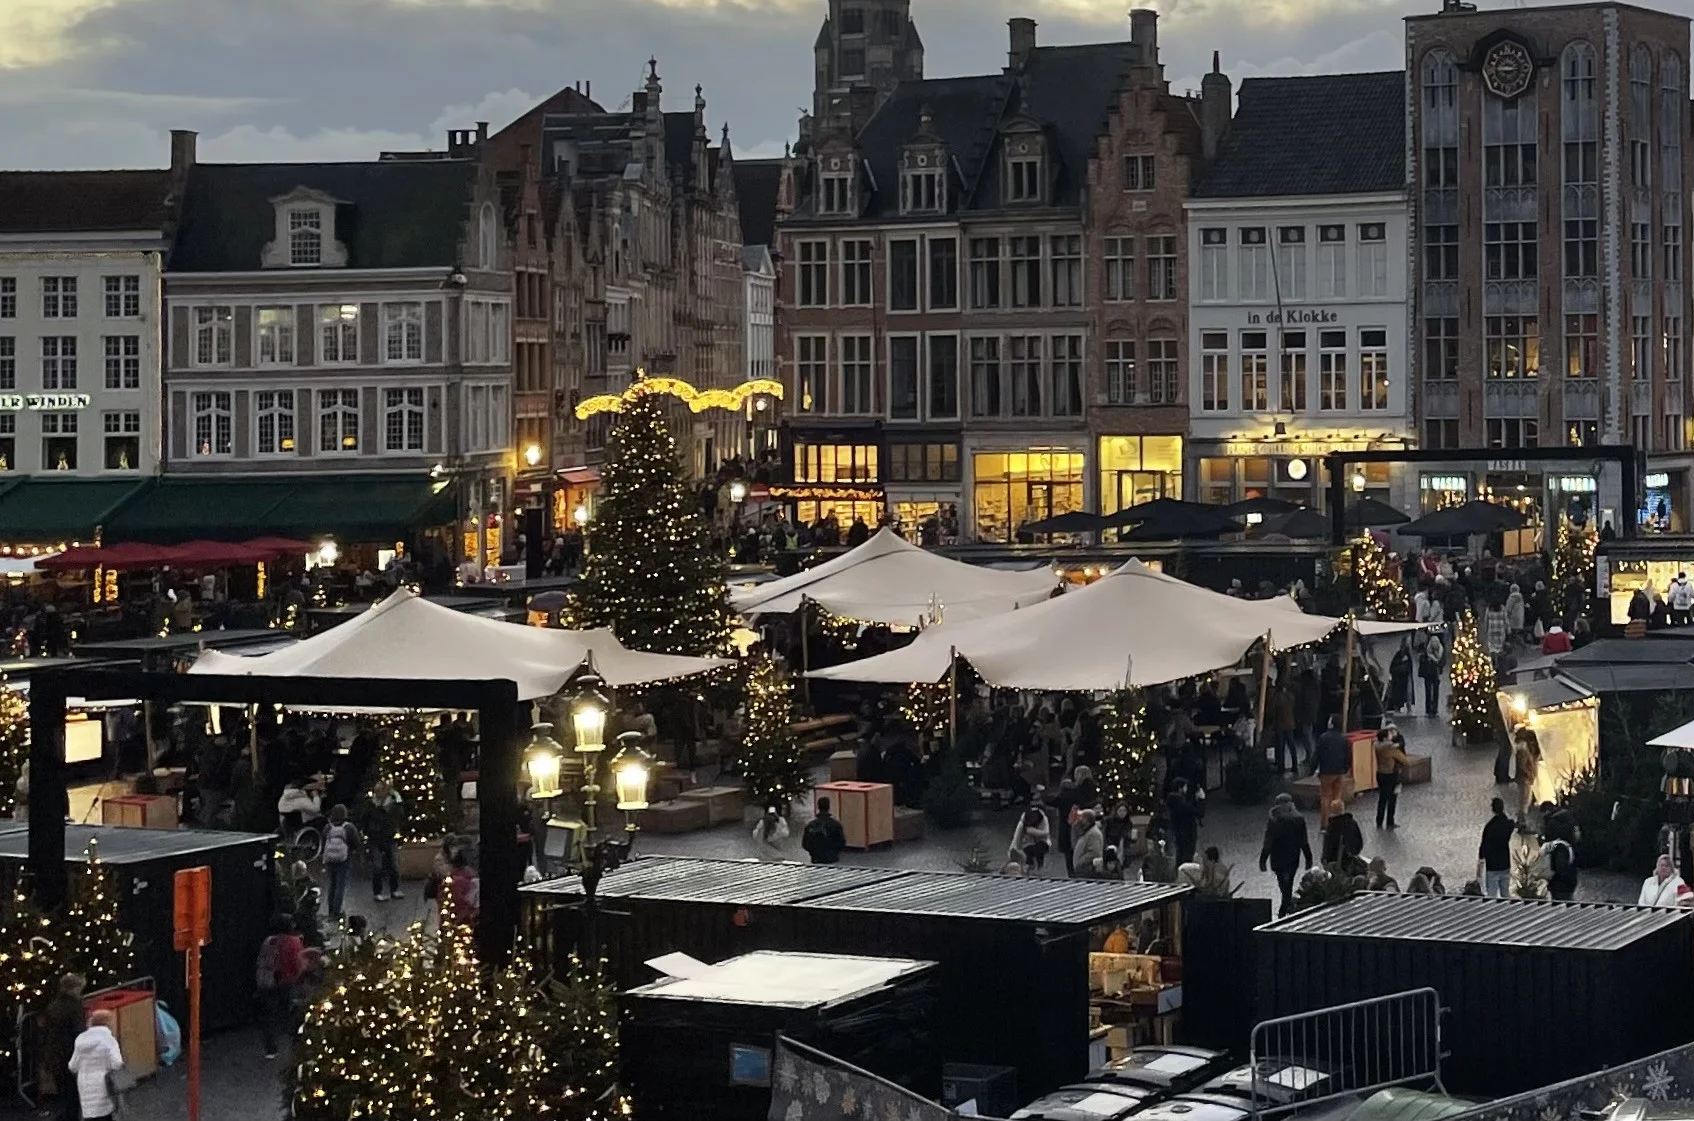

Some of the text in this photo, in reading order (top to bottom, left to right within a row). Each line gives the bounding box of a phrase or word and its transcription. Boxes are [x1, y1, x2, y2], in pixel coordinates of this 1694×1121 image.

[1247, 309, 1338, 324] in de Klokke
[1487, 460, 1527, 471] WASBAR
